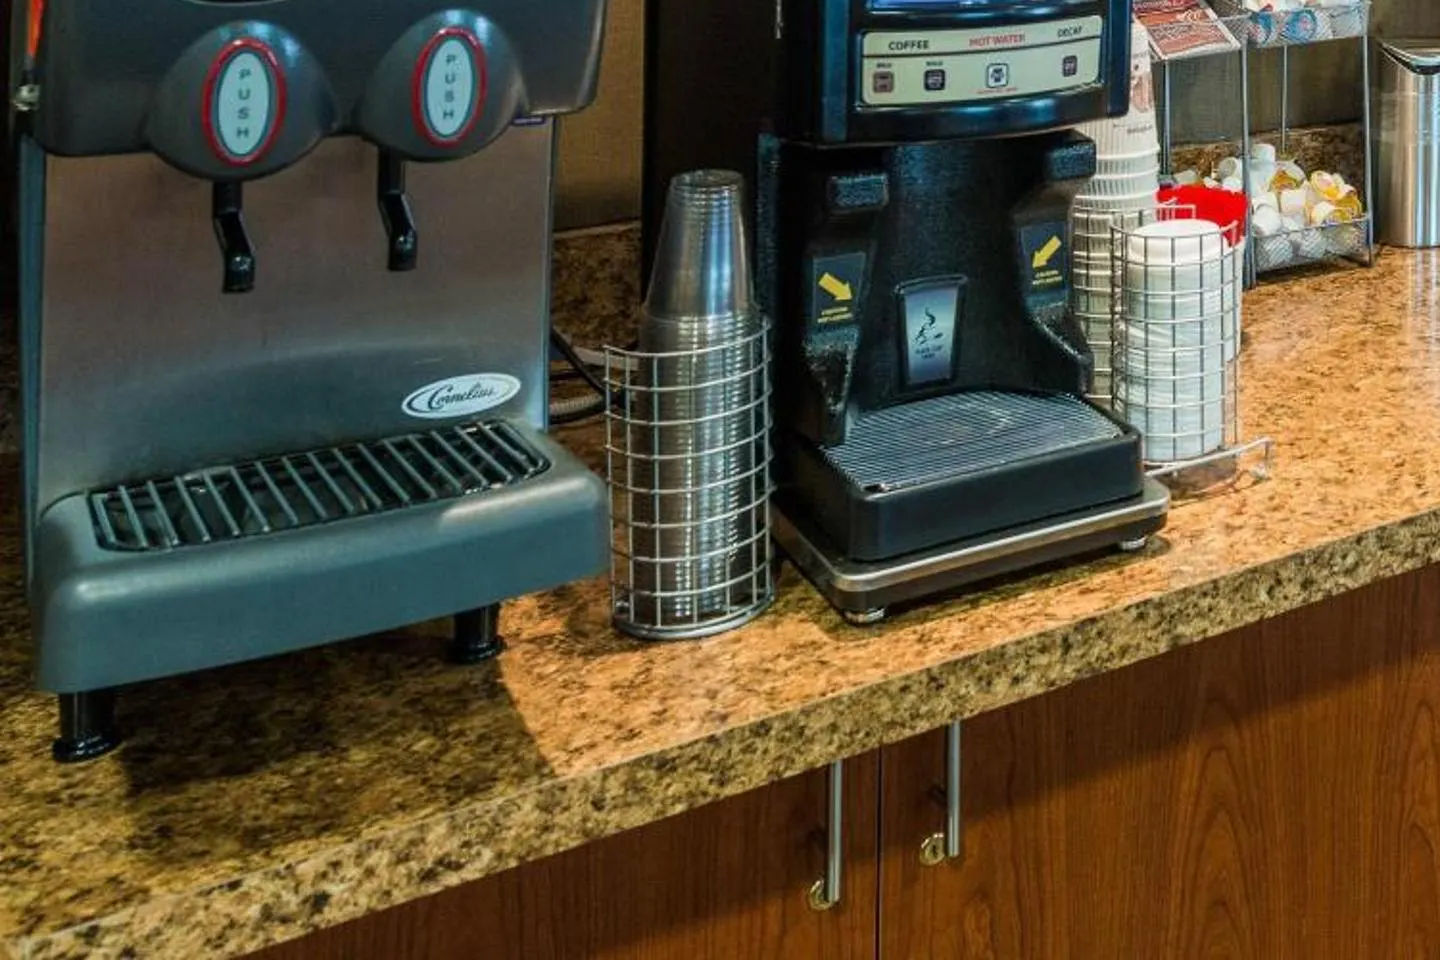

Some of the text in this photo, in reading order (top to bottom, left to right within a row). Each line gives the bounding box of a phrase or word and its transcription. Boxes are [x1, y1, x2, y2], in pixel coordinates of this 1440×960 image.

[888, 39, 929, 51] COFFEE
[236, 67, 252, 140] PUSH
[443, 53, 457, 121] PUSH
